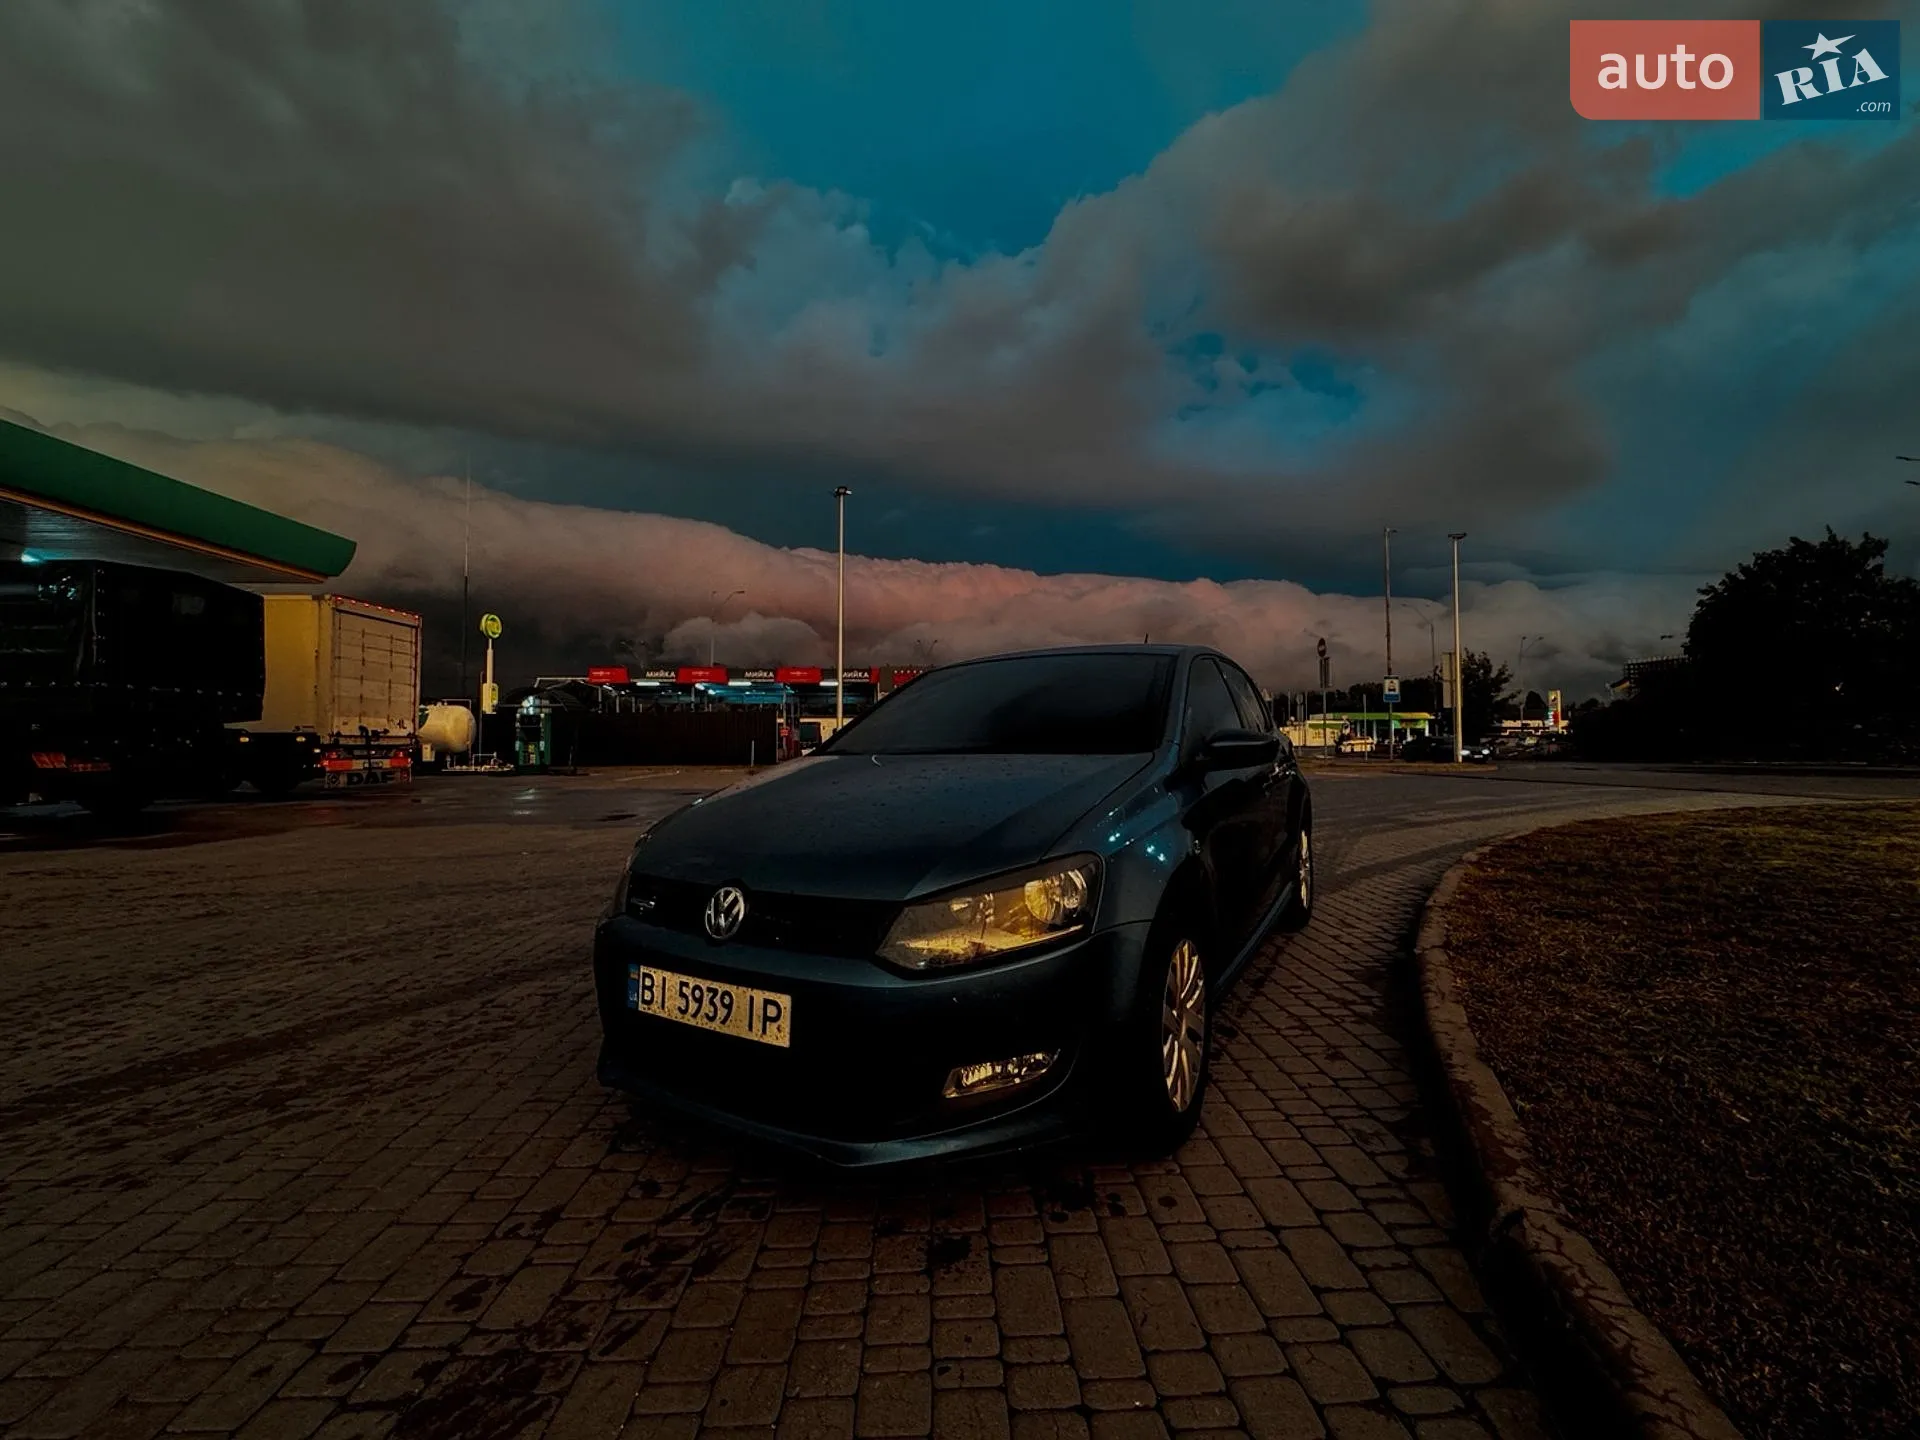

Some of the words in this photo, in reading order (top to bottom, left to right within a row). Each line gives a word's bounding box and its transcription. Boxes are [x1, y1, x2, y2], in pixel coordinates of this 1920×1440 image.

[646, 668, 676, 678] МИЙКА
[745, 669, 774, 678] МИЙКА
[641, 972, 666, 1010] BI
[677, 981, 733, 1024] 5939
[748, 995, 782, 1034] IP
